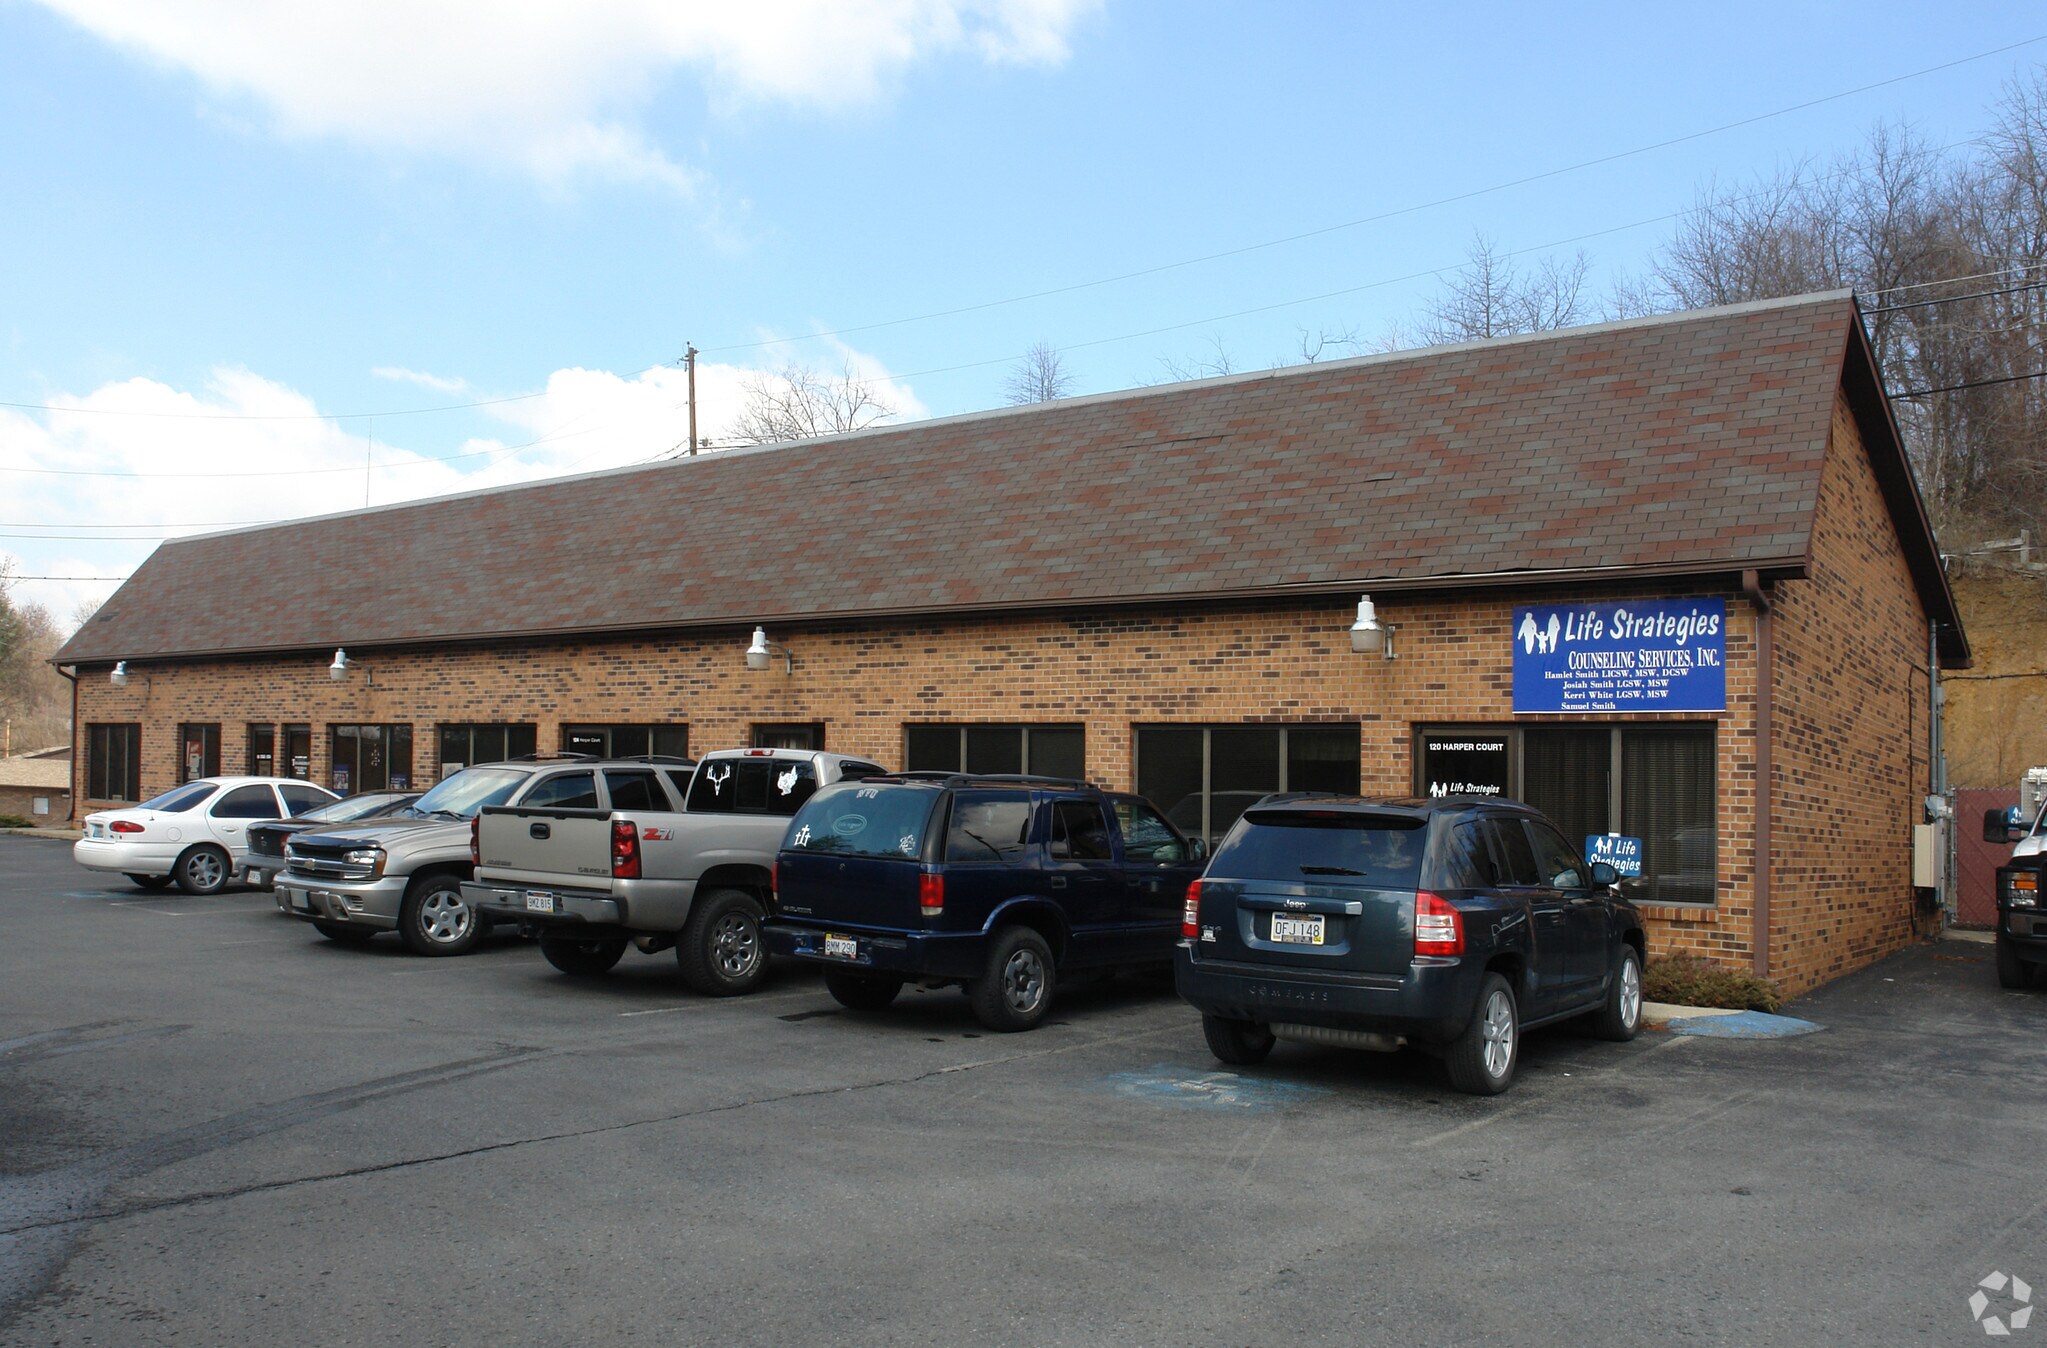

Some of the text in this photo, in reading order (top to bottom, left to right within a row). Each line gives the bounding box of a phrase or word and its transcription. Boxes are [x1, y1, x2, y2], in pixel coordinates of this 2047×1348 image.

[1565, 608, 1720, 646] Life Strategies
[1568, 647, 1720, 670] COUNSELING SERVICES, INC.
[1544, 668, 1689, 679] Hamlet Smith LICSW, MSW, DCSW
[1563, 681, 1587, 689] Josiah
[1590, 680, 1614, 688] Smith
[1647, 679, 1669, 687] MSW
[1563, 691, 1586, 699] Kerri
[1589, 690, 1613, 699] White
[1647, 690, 1669, 698] MSW
[1561, 701, 1616, 710] Samuel Smith
[1429, 743, 1504, 751] 120 HARPER COURT
[1450, 782, 1500, 796] Life Strategies
[642, 828, 675, 841] Z71
[1616, 840, 1636, 855] Life
[1283, 899, 1307, 910] Jeep
[1301, 924, 1320, 937] 148
[841, 942, 857, 954] 290
